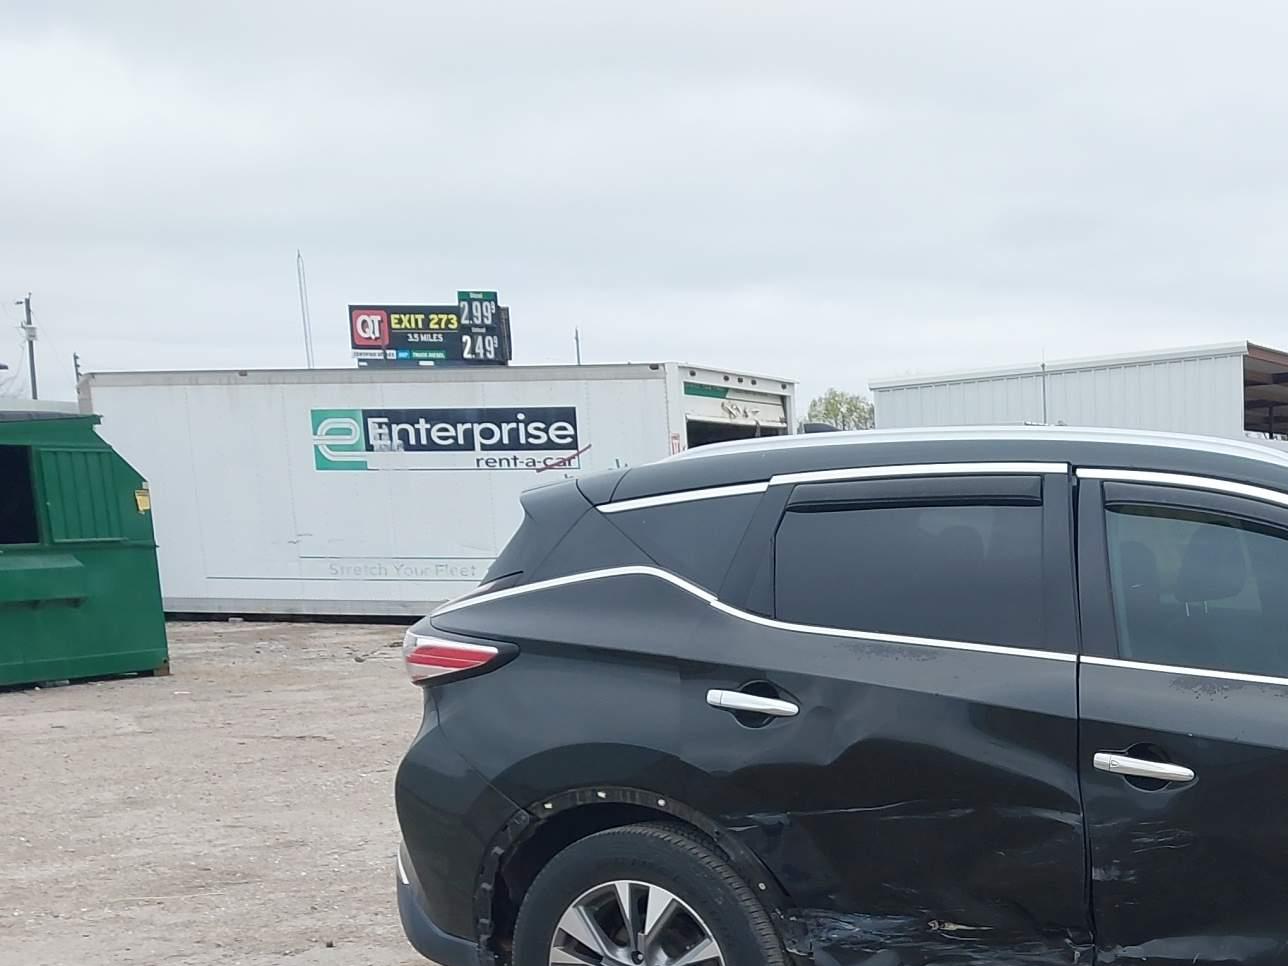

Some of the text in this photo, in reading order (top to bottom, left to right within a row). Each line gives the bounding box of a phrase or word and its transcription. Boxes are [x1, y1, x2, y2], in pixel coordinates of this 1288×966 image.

[356, 315, 382, 340] QT
[391, 314, 458, 328] EXIT 273
[407, 333, 444, 342] 3.5 MILES
[367, 412, 576, 452] Enterprise
[476, 454, 576, 468] rent-a-car
[328, 562, 477, 578] Stretch Your Fleet
